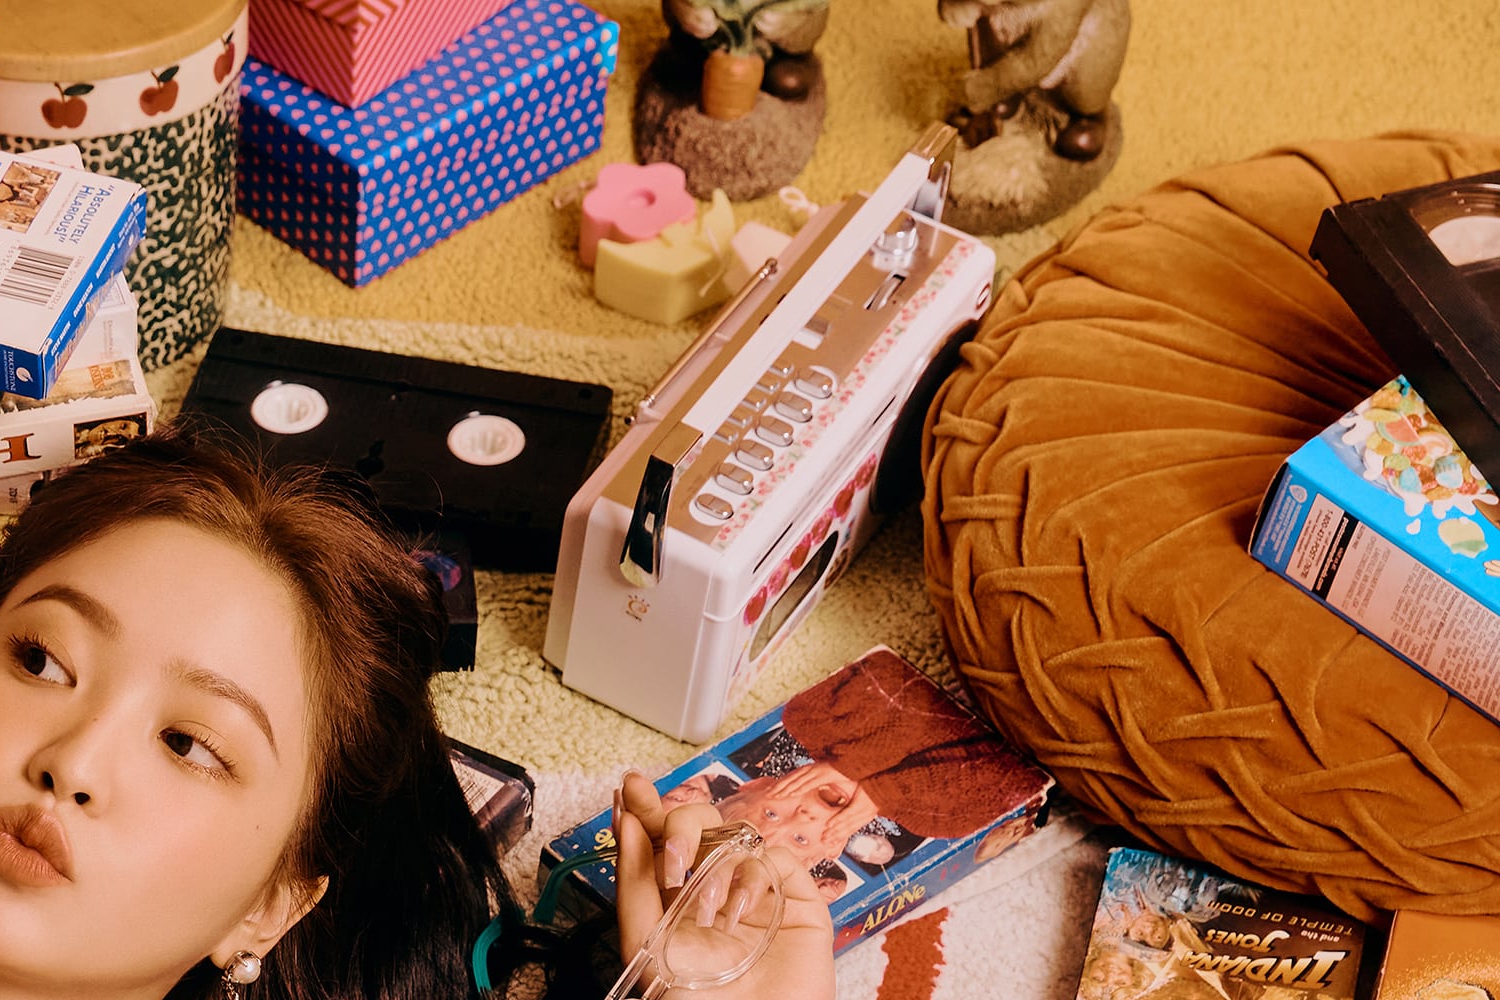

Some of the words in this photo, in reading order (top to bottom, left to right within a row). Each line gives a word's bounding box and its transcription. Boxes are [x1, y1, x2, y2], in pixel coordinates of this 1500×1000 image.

[1206, 900, 1257, 918] DOOM
[1261, 912, 1284, 922] OF
[1289, 916, 1353, 936] TEMPLE
[1300, 930, 1318, 940] the
[1205, 929, 1290, 952] JONES
[1319, 932, 1340, 943] and
[1181, 951, 1347, 990] INDIANA
